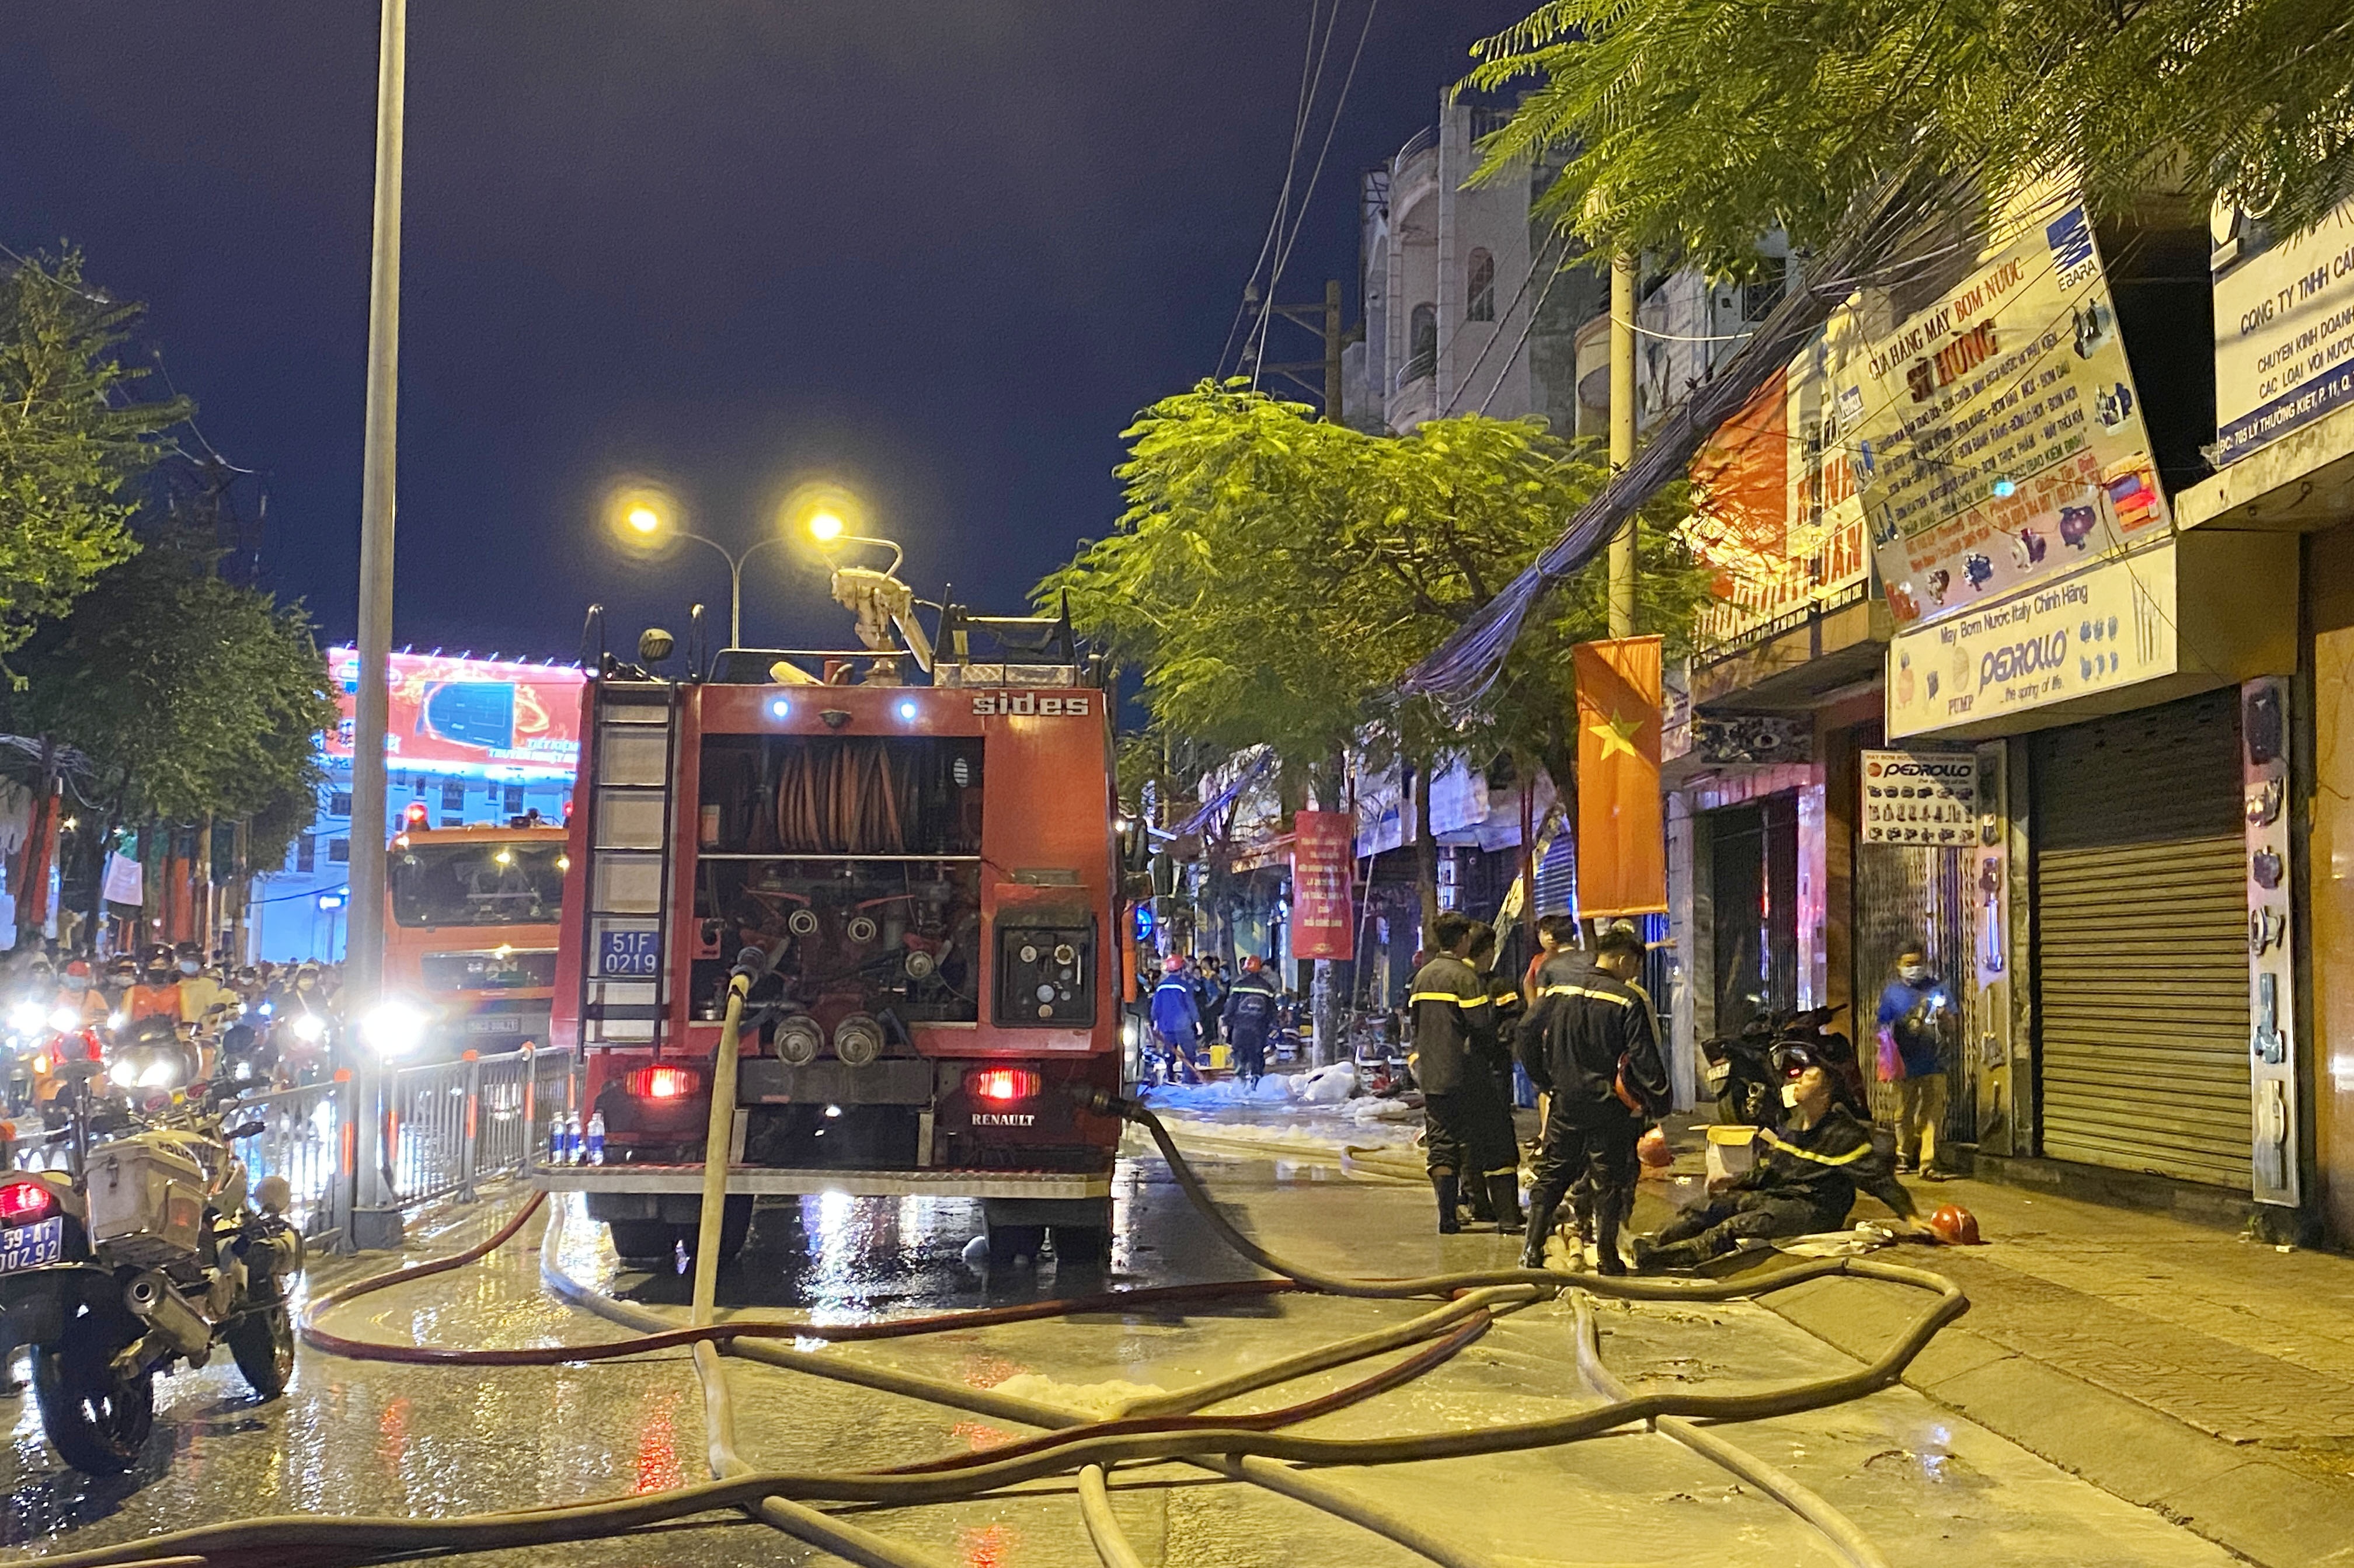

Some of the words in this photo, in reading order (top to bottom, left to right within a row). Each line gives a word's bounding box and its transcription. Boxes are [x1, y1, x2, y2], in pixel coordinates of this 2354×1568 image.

[2058, 259, 2098, 292] EBARA
[2278, 285, 2294, 313] TY
[2298, 263, 2329, 301] TNHH
[1889, 329, 1923, 367] HÀNG
[1925, 308, 1951, 343] MÁY
[2296, 327, 2317, 353] KINH
[2248, 418, 2259, 440] LÝ
[2012, 601, 2031, 623] Italy
[1978, 630, 2067, 696] PEDROLLO
[2042, 677, 2050, 692] of
[973, 692, 1088, 715] sides
[1948, 695, 1974, 715] PUMP
[1883, 764, 1971, 778] PEDROLLO
[613, 933, 650, 953] 51F
[606, 953, 656, 973] 0219
[971, 1113, 1035, 1126] RENAULT
